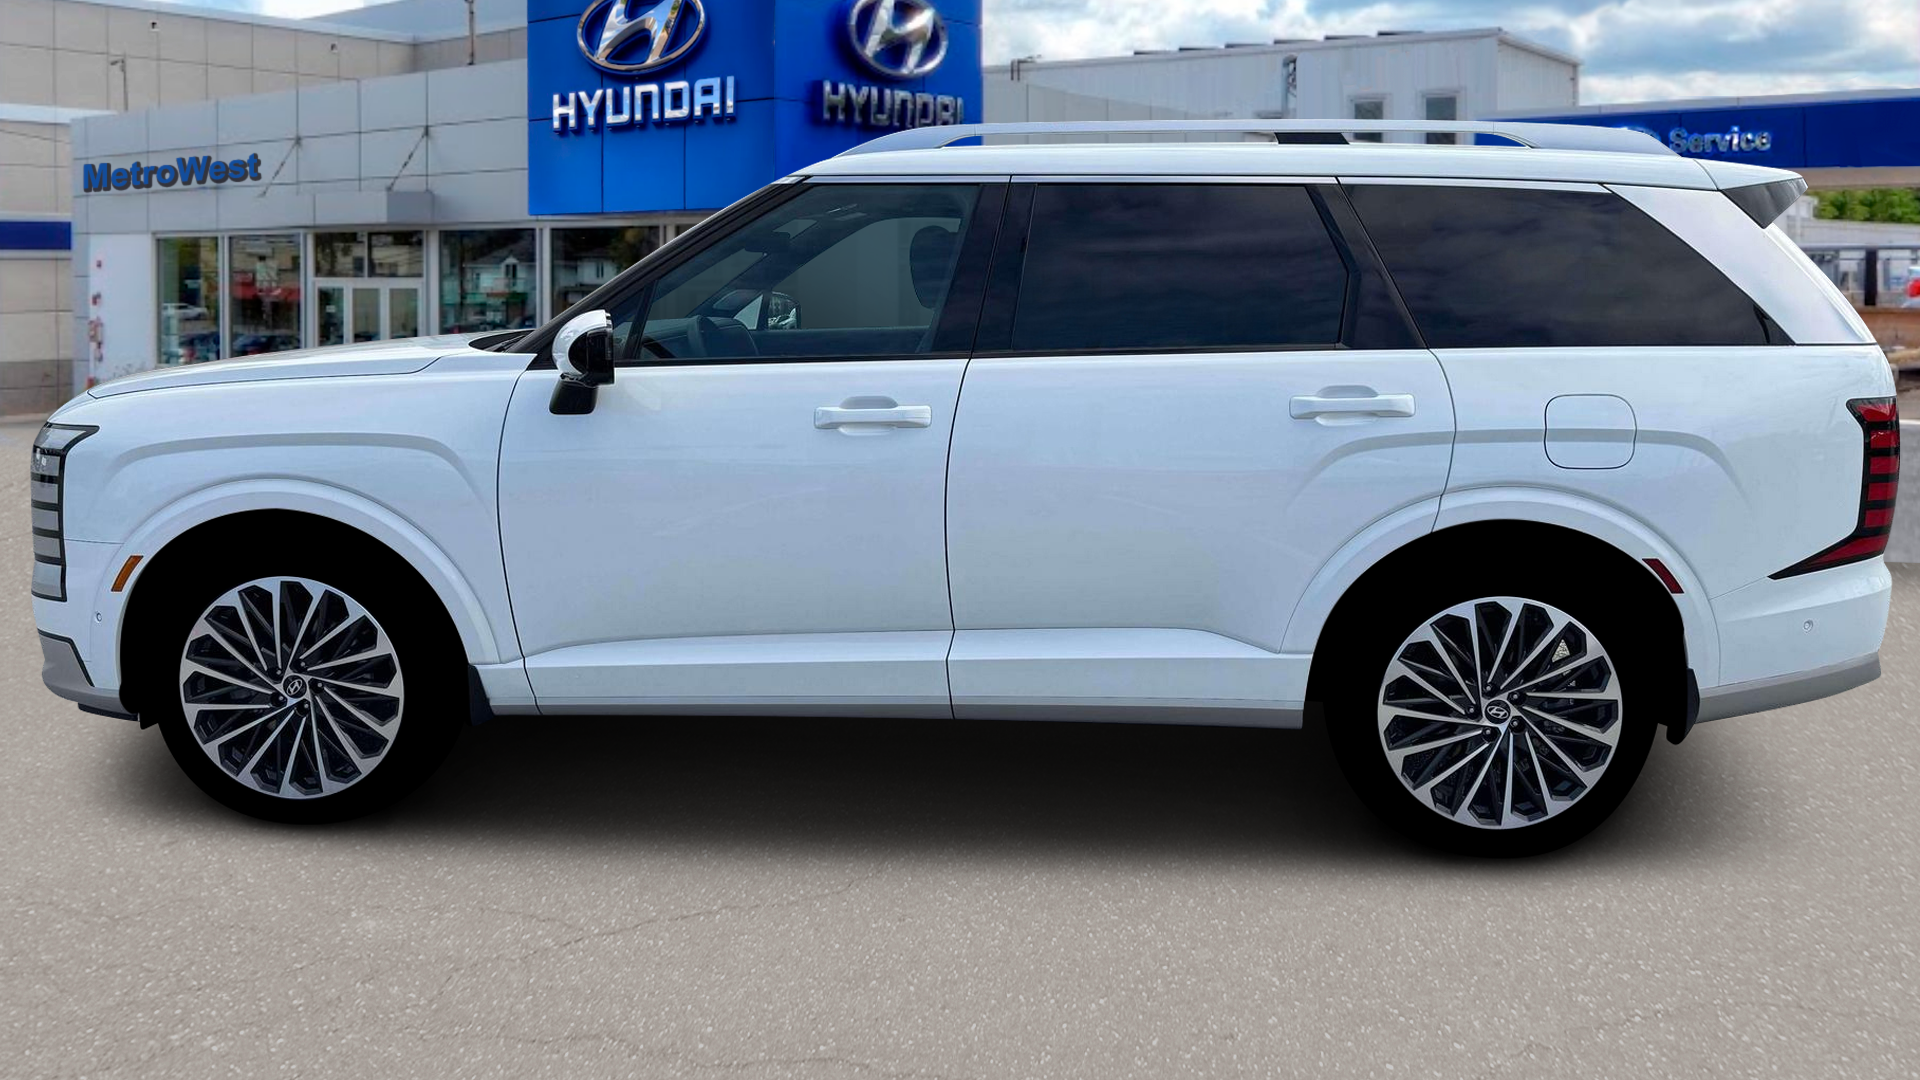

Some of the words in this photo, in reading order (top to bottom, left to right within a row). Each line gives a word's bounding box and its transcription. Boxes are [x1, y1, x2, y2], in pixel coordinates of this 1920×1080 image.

[553, 76, 735, 130] HYUNDAI
[823, 80, 964, 128] HYUNDAI
[1669, 126, 1772, 153] Service
[83, 153, 261, 192] MetroWest
